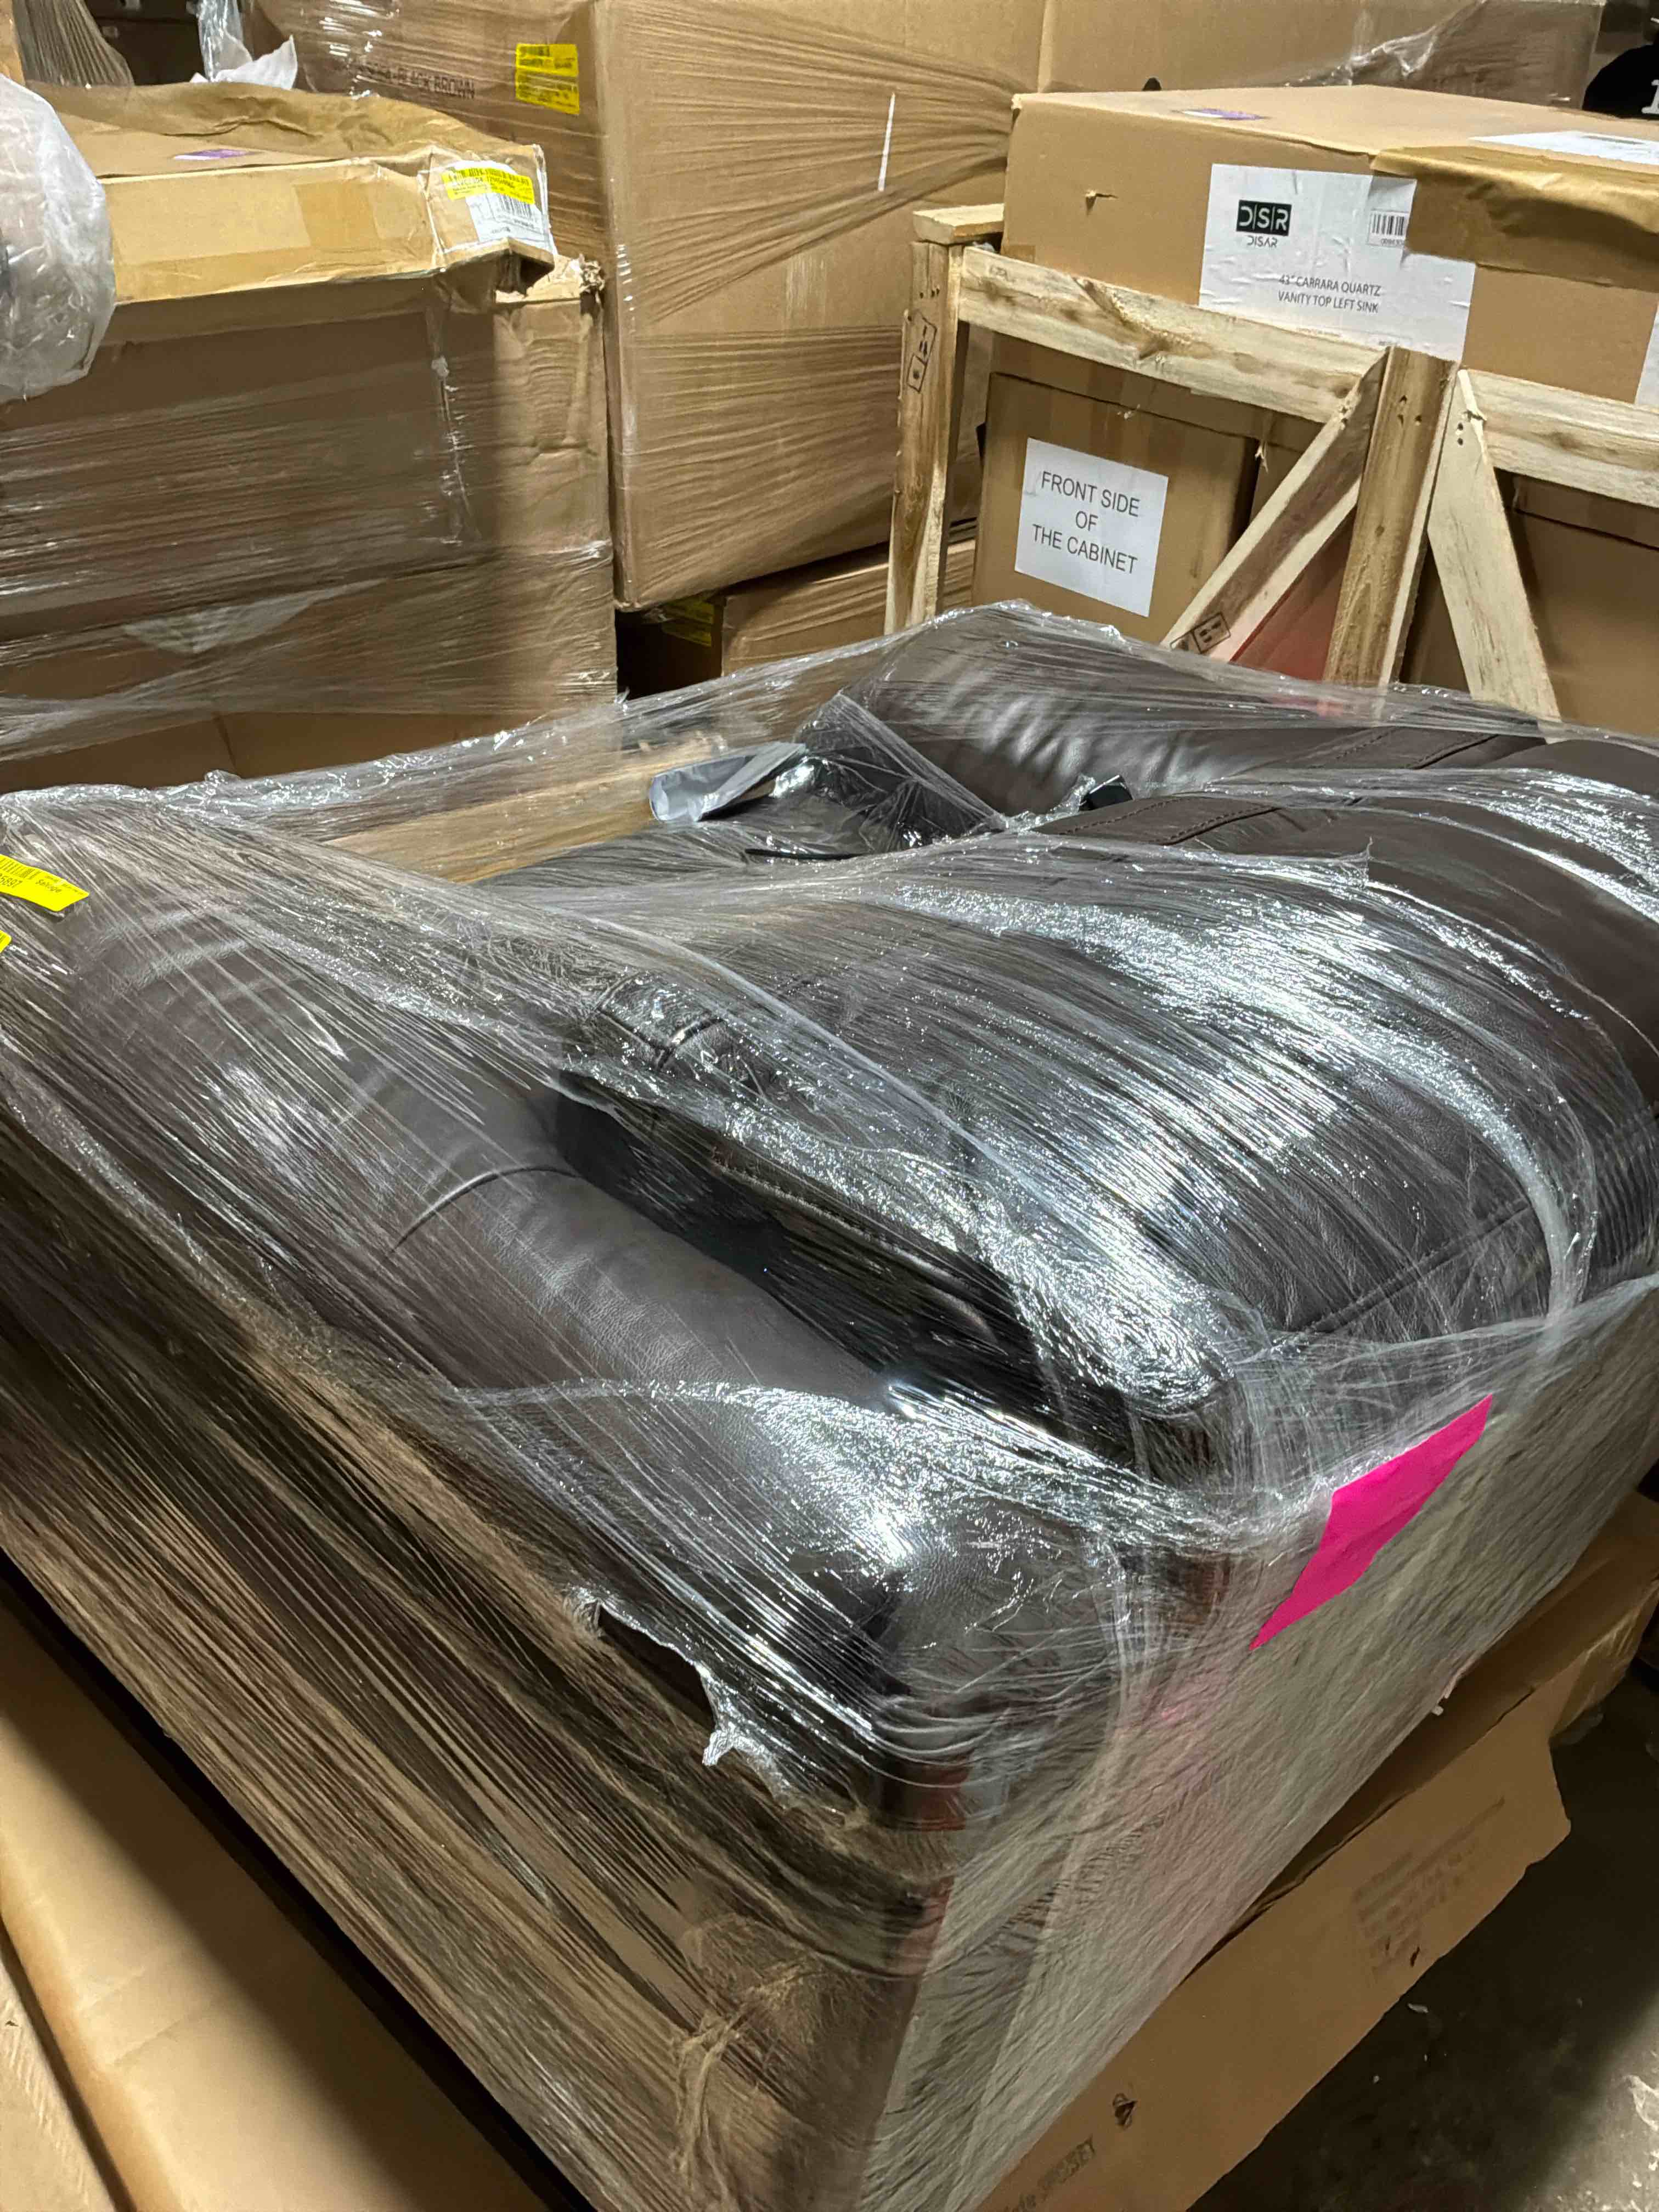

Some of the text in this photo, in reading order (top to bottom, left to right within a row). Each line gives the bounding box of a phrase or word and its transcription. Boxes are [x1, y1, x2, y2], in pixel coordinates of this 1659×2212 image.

[1246, 235, 1278, 248] DISAR
[1296, 277, 1339, 292] CARRARA
[1341, 281, 1381, 297] QUARTZ
[1278, 291, 1379, 314] VANITY TOP LEFT SINK
[1041, 471, 1140, 517] FRONT SIDE
[1075, 511, 1098, 532] OF
[1032, 524, 1138, 574] THE CABINET
